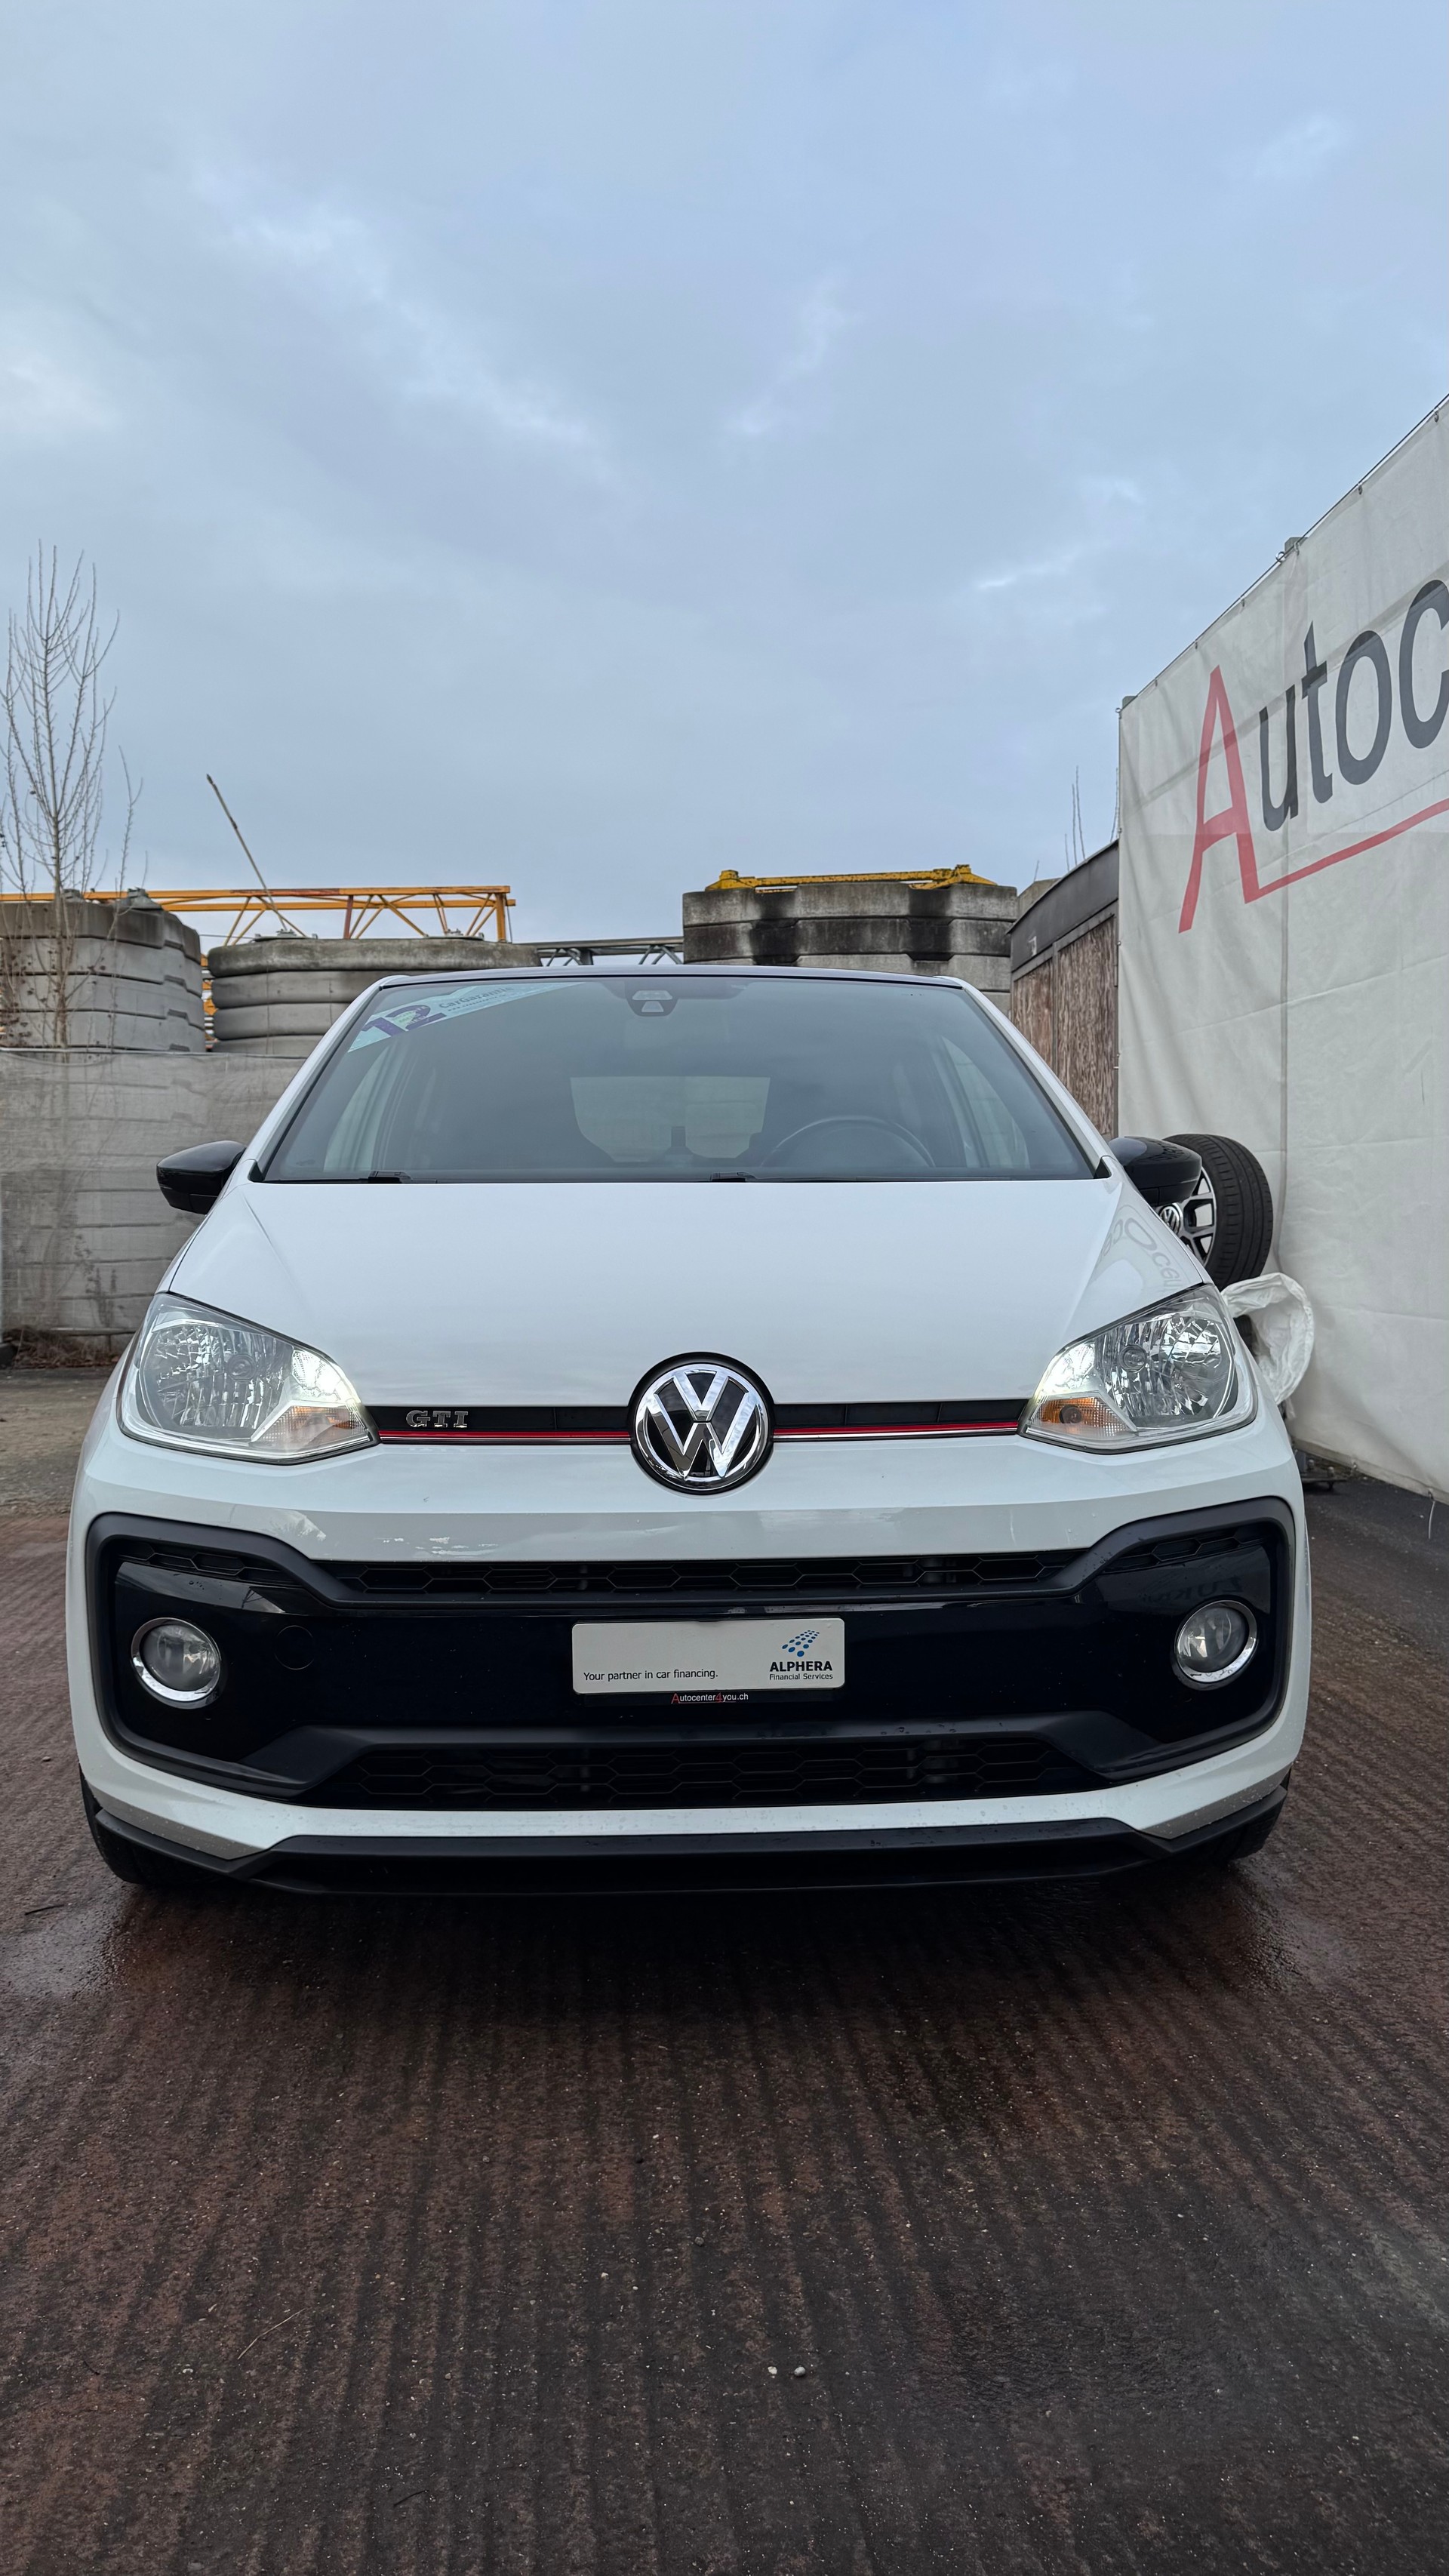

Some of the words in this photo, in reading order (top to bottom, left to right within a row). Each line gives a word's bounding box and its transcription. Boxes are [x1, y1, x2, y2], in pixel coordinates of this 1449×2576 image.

[1177, 579, 1449, 933] Autoc
[405, 1410, 469, 1429] GTI
[642, 1366, 761, 1482] VW
[769, 1660, 833, 1673] ALPHERA
[583, 1671, 605, 1681] Your
[608, 1670, 642, 1682] partner
[645, 1670, 654, 1679] in
[656, 1670, 671, 1679] car
[673, 1668, 718, 1680] financing.
[671, 1692, 749, 1704] Autocenter4you.ch
